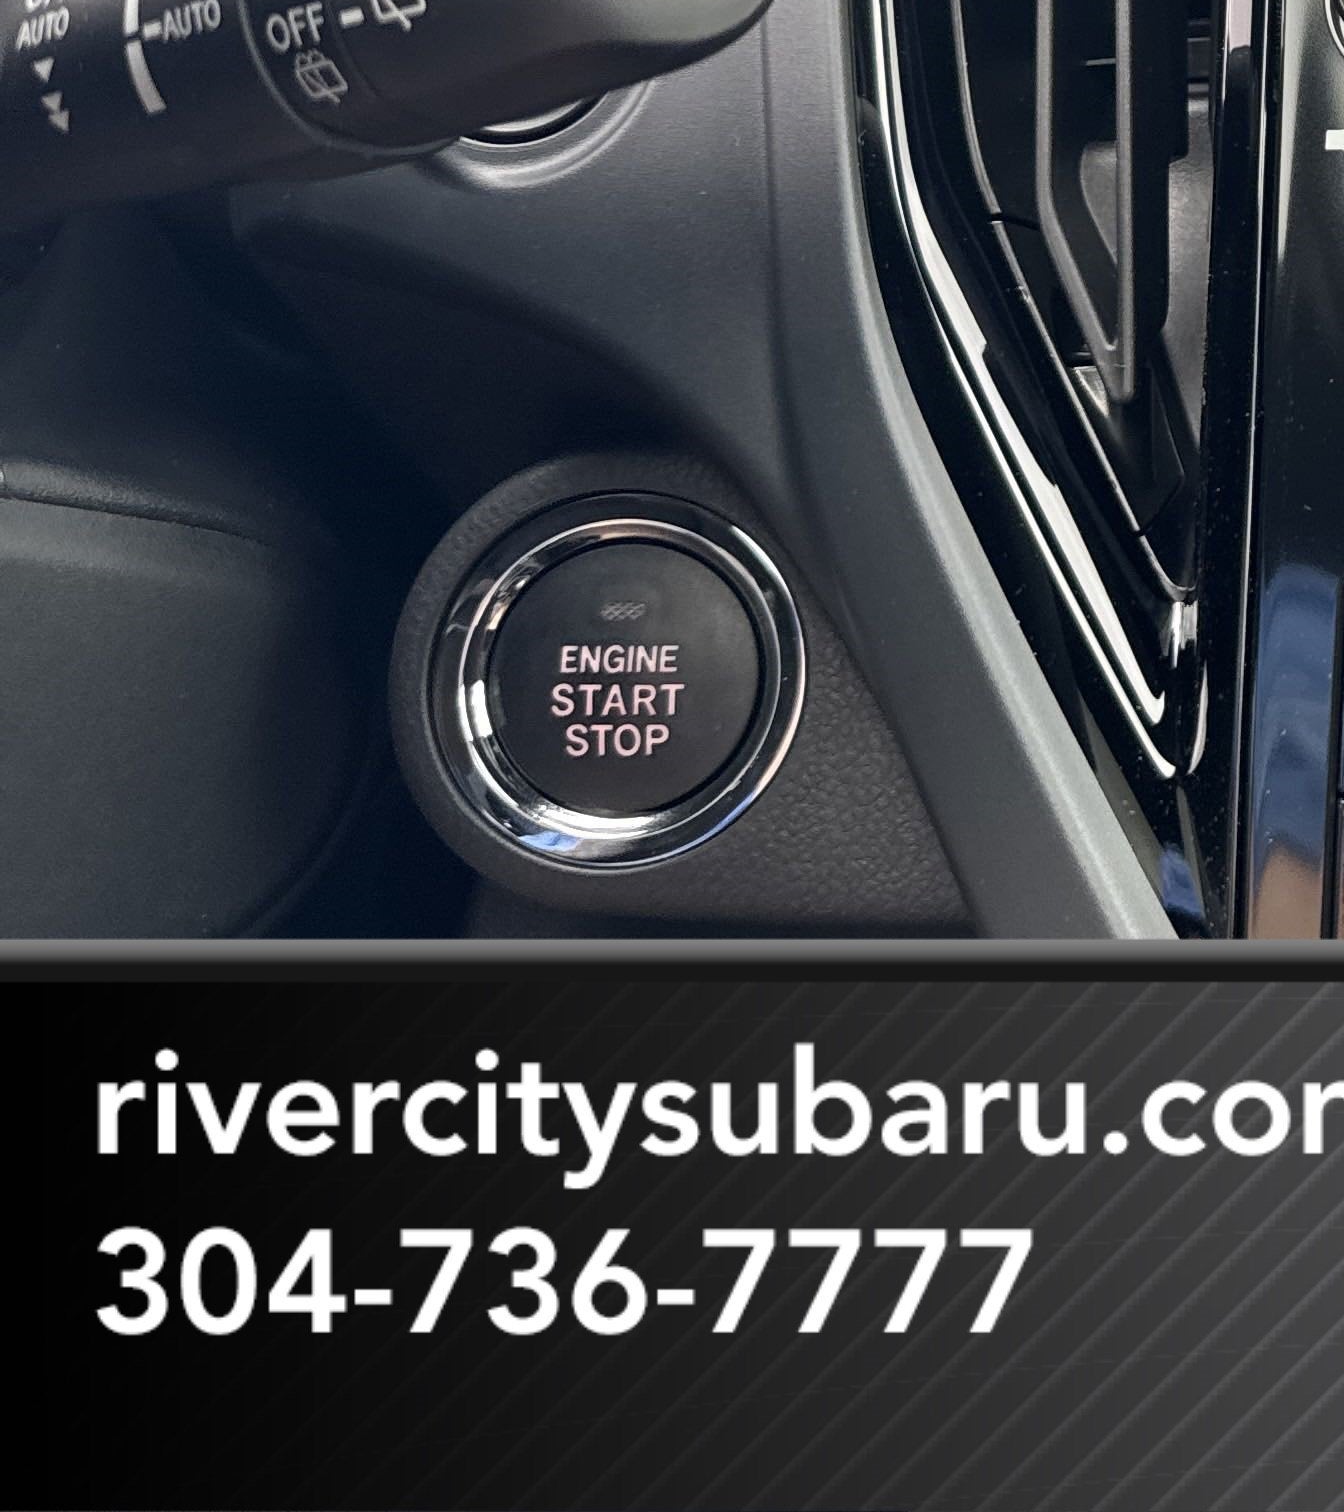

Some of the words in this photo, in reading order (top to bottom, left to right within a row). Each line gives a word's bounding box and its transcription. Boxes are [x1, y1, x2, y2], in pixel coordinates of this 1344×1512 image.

[16, 6, 70, 51] AUTO
[266, 0, 325, 53] OFF
[559, 644, 680, 674] ENGINE
[550, 683, 684, 718] START
[565, 724, 670, 758] STOP
